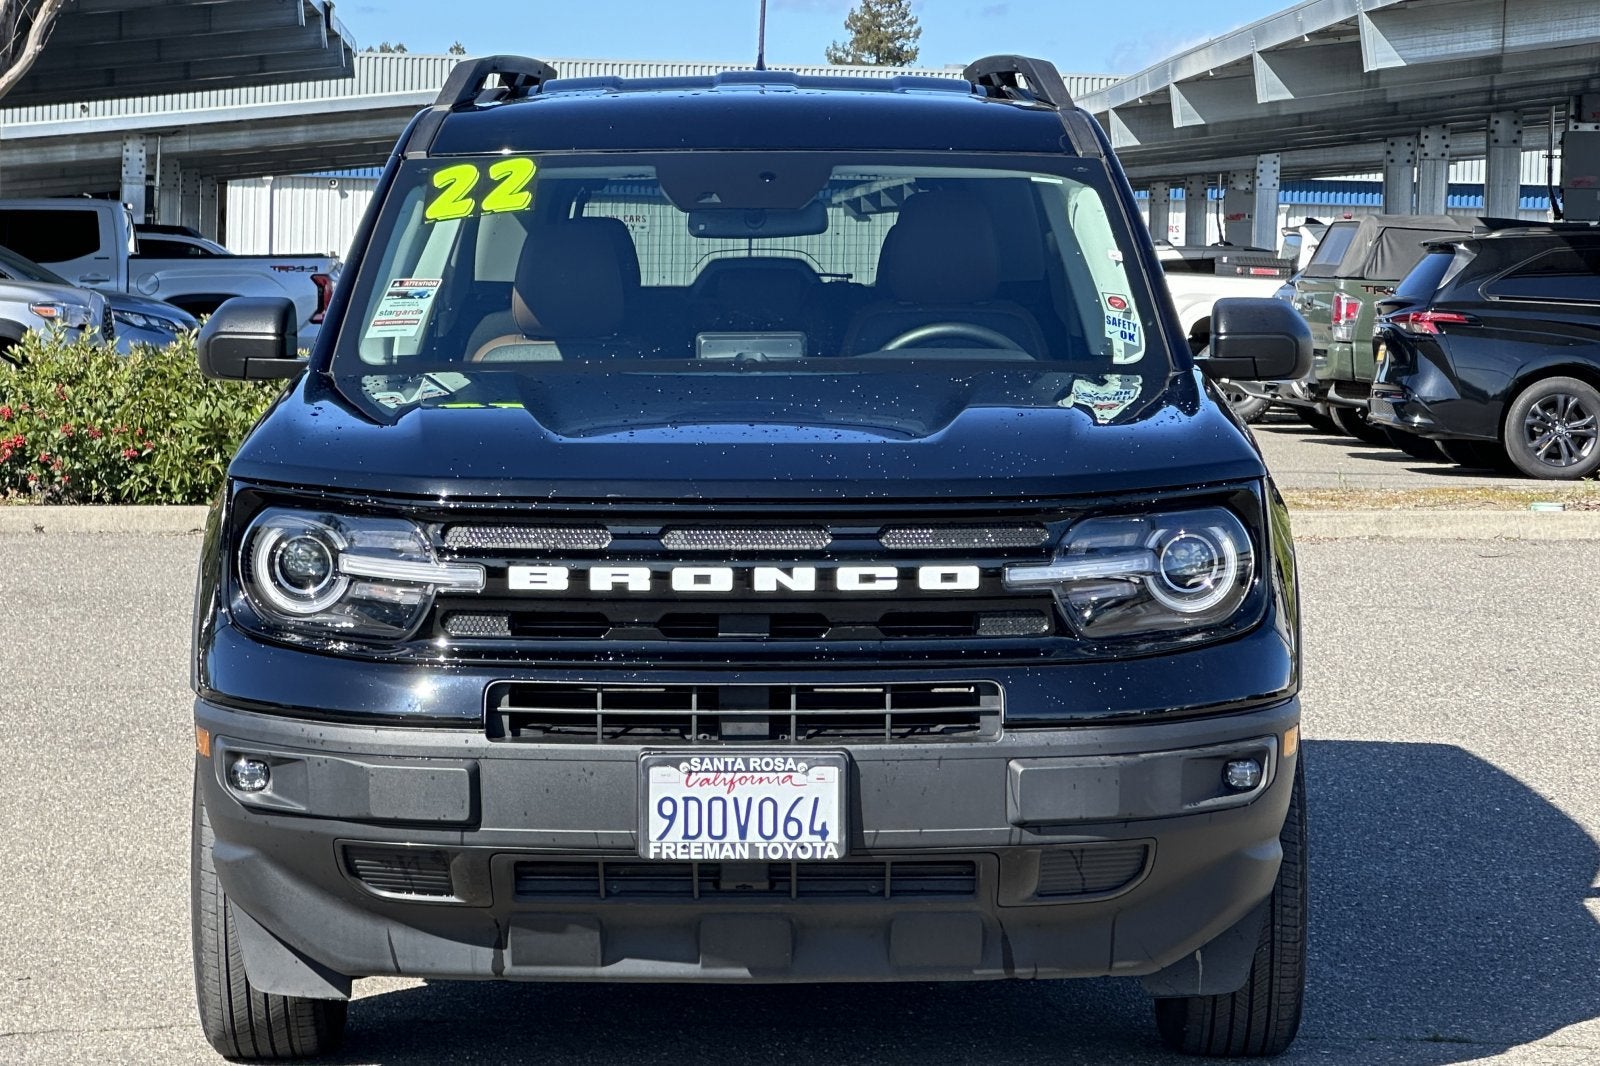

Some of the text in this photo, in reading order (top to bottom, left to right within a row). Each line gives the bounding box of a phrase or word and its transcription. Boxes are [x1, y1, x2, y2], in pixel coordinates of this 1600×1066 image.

[425, 158, 537, 223] 22
[623, 214, 647, 223] CARS
[1361, 284, 1397, 295] TR
[1105, 315, 1137, 332] SAFETY
[1120, 330, 1136, 343] OK
[508, 565, 980, 592] BRONCO
[690, 757, 796, 772] SANTA ROSA
[685, 772, 807, 794] California
[650, 842, 839, 860] FREEMAN TOYOTA
